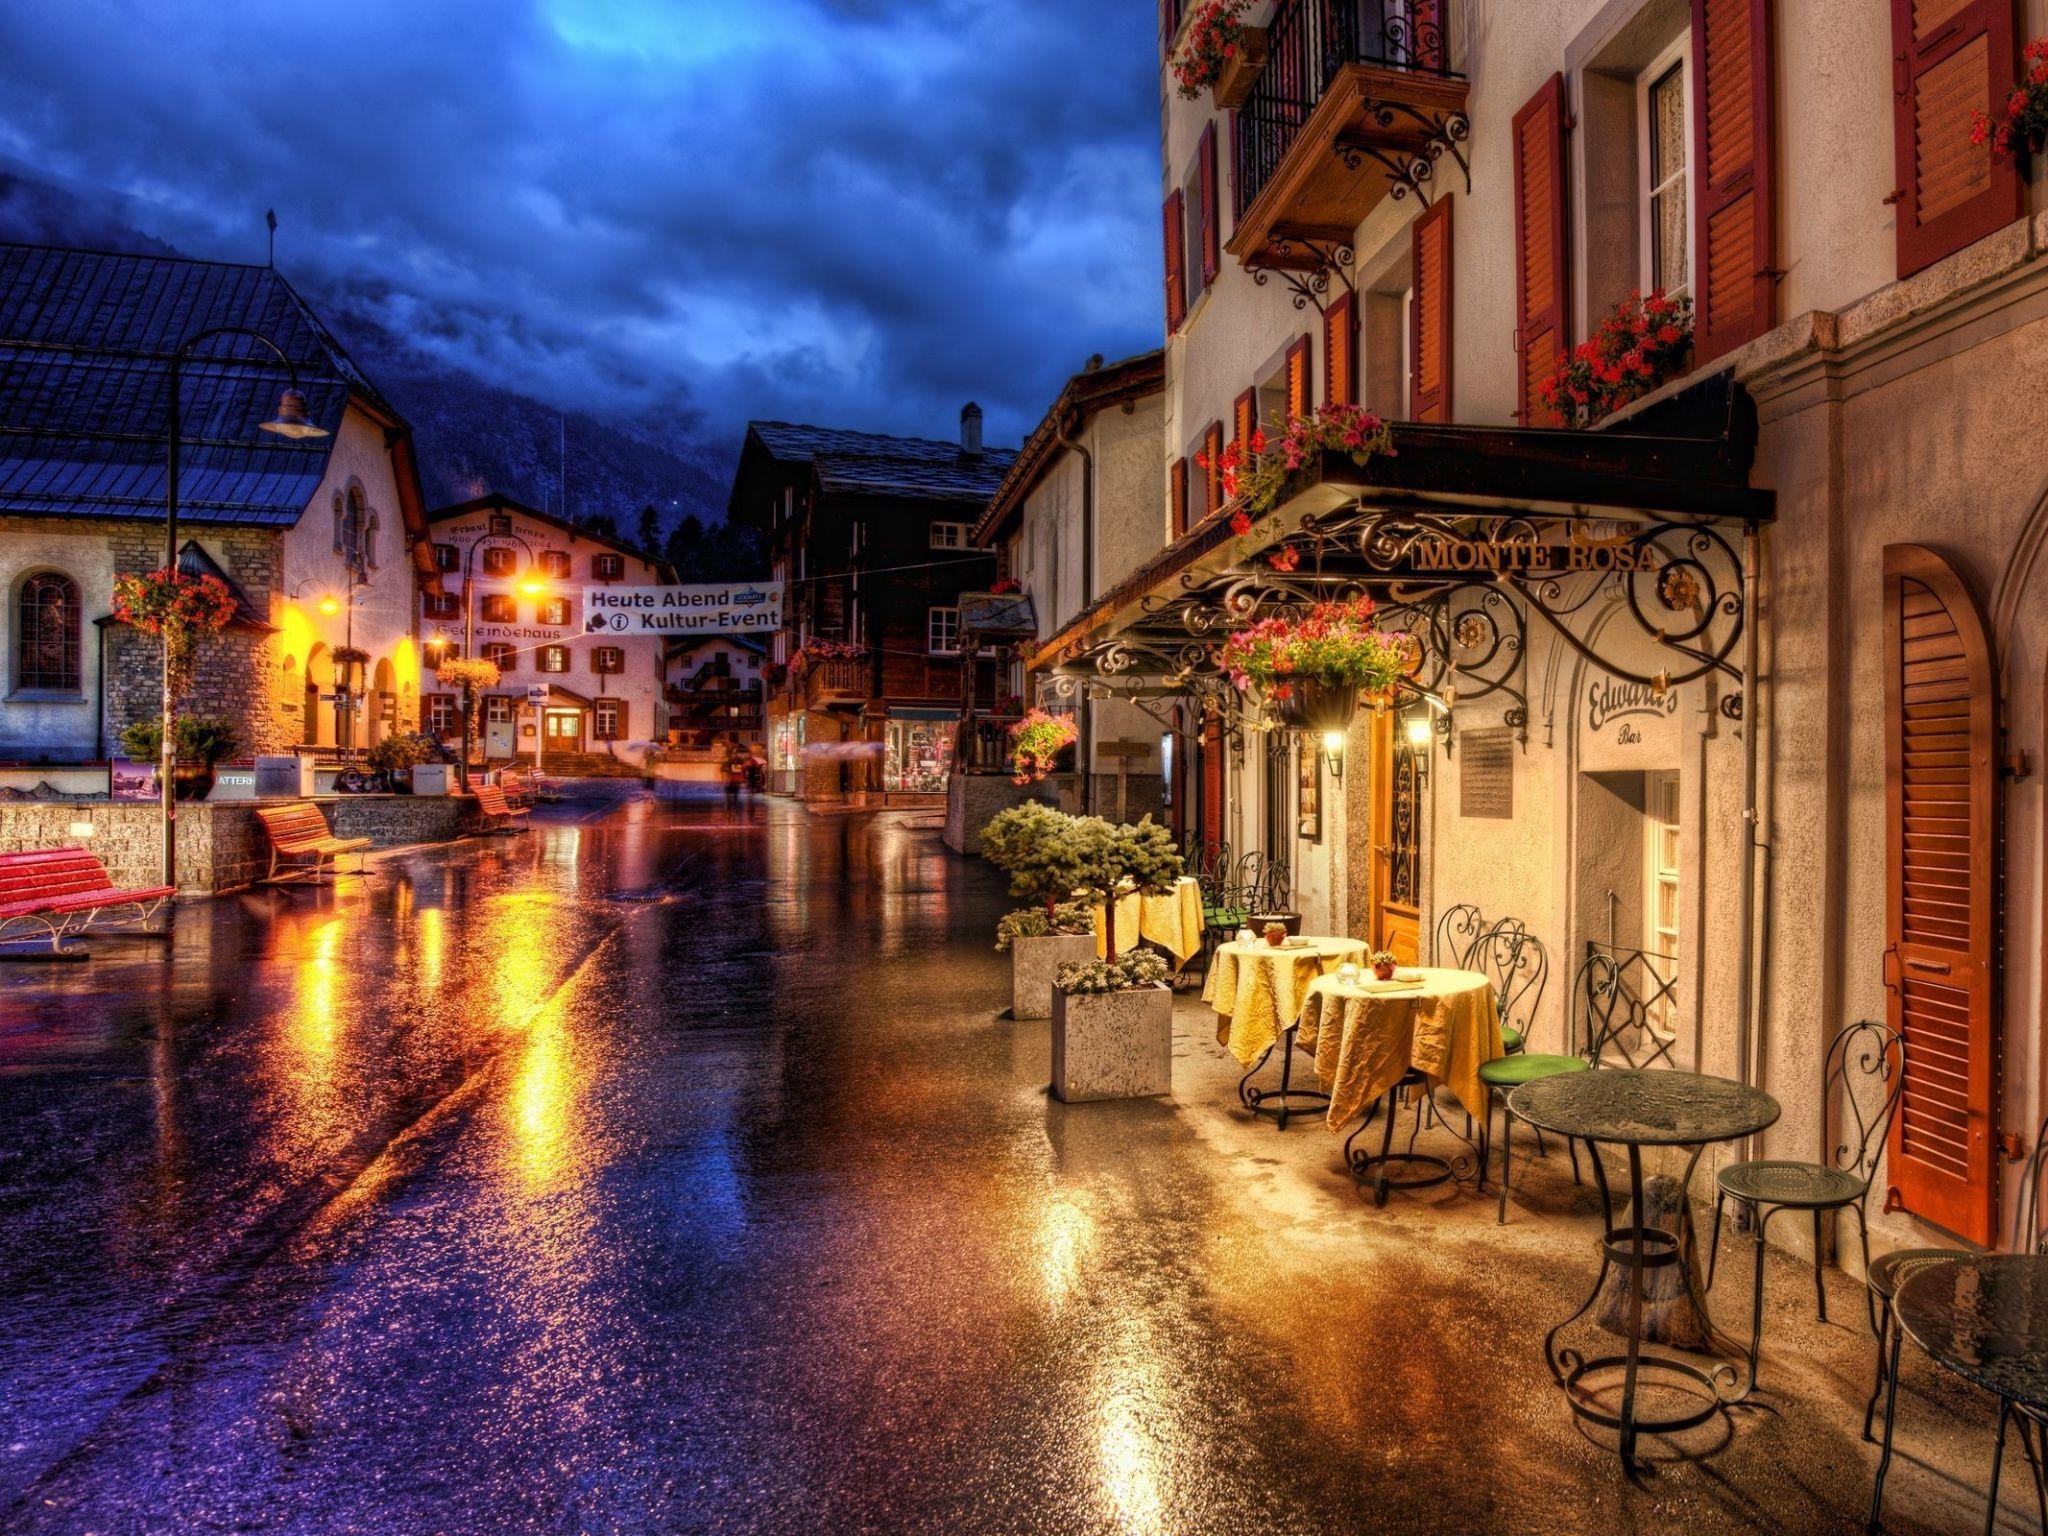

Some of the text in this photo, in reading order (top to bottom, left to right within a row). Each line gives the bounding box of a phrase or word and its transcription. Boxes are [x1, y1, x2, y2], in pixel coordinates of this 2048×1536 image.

[1417, 541, 1660, 572] MONTE ROSA
[591, 592, 655, 608] Heute
[662, 590, 729, 607] Abend
[641, 610, 779, 629] Kultur-Event
[1618, 723, 1642, 745] Bar
[216, 776, 256, 785] ATTERH
